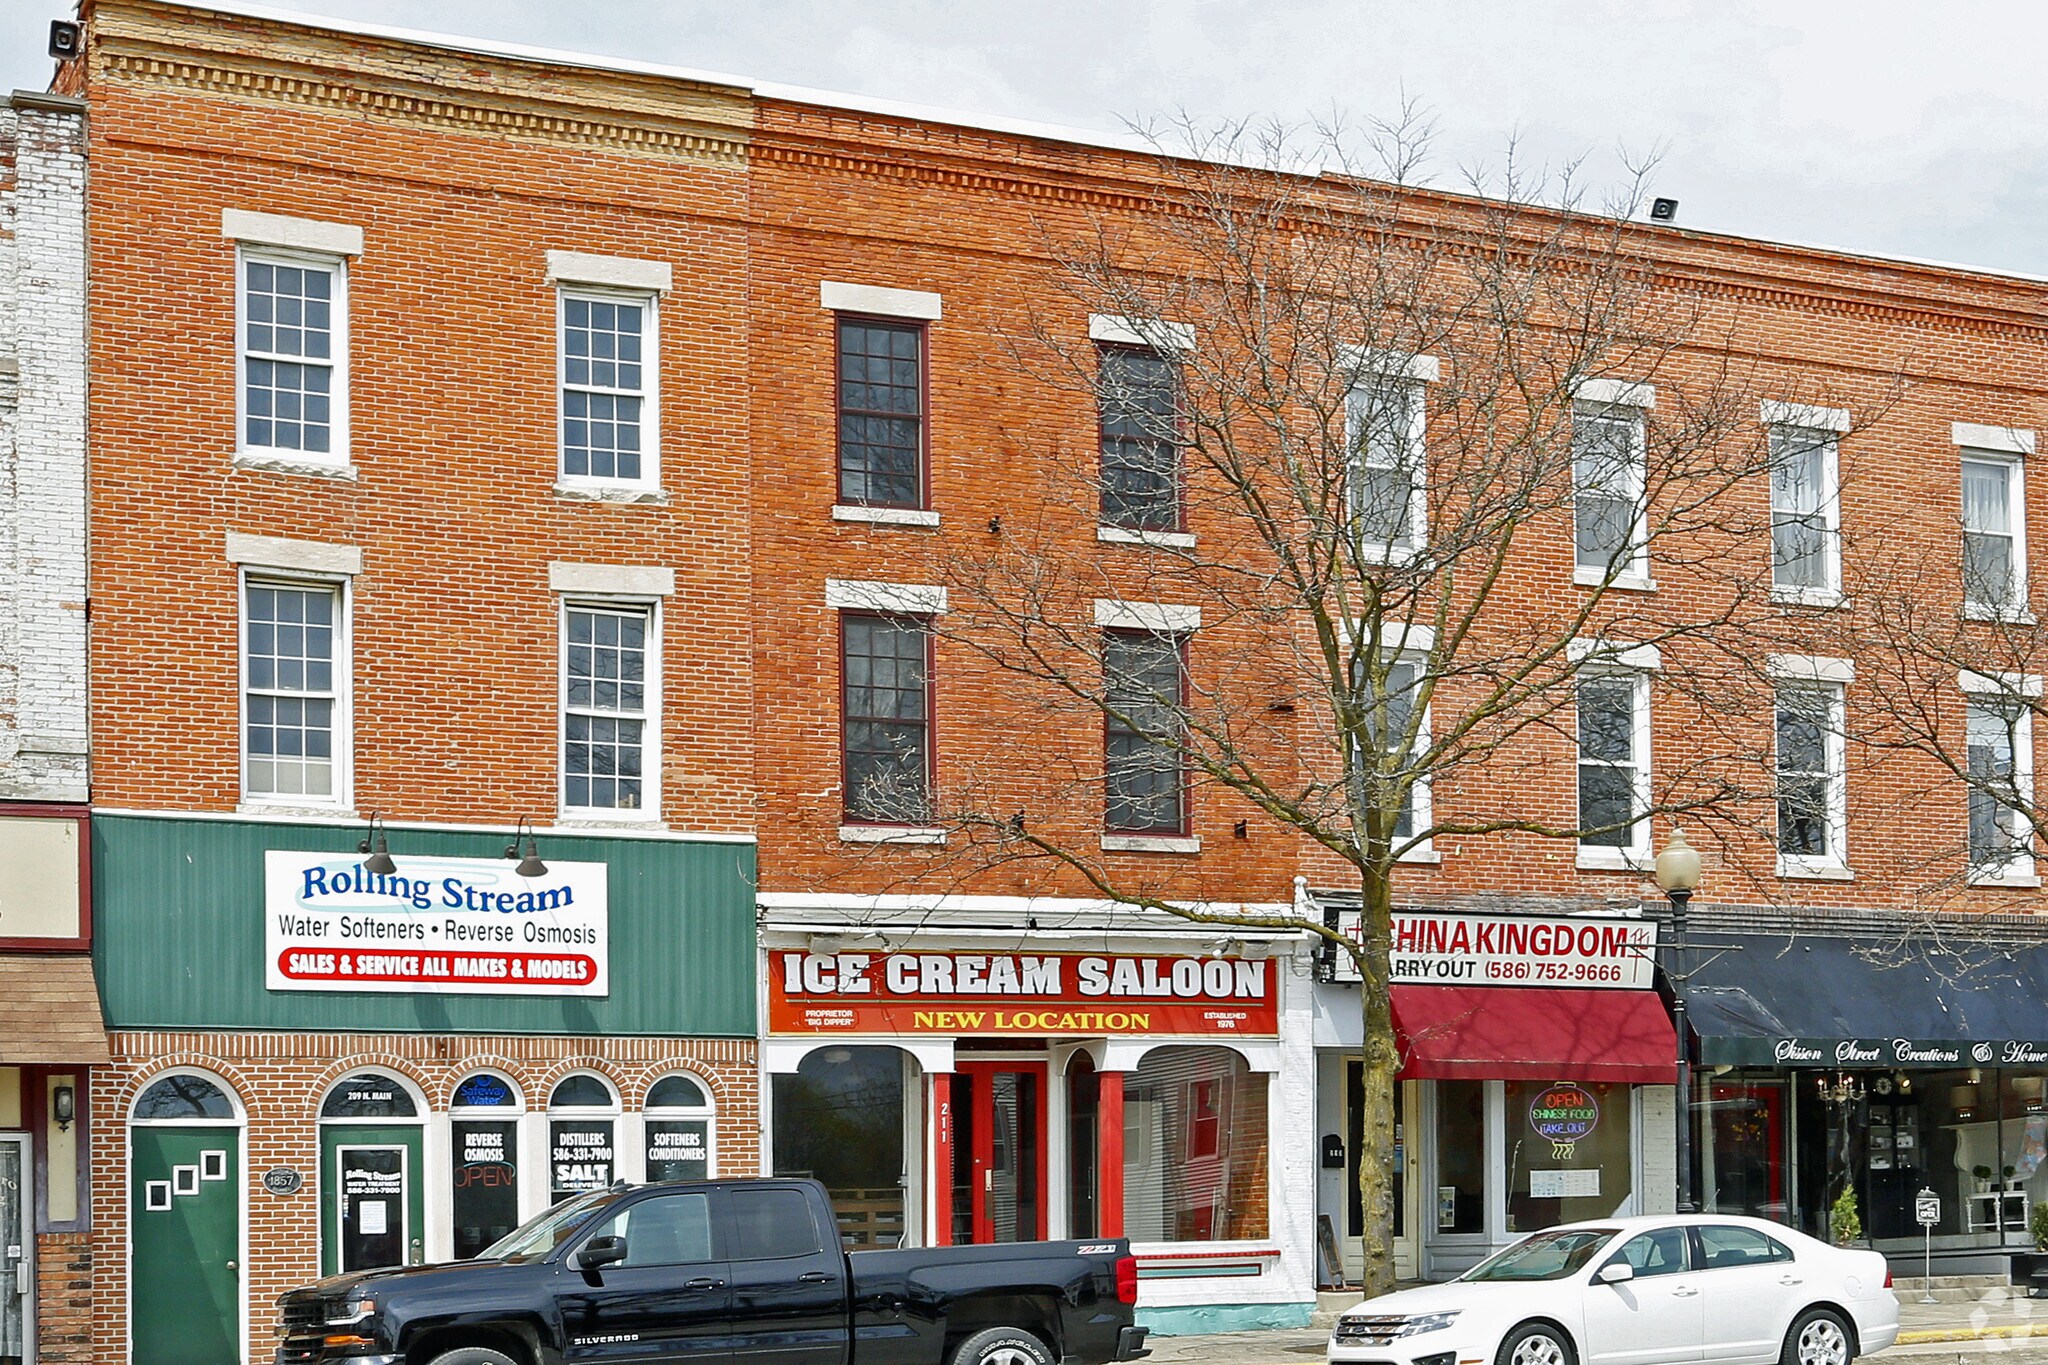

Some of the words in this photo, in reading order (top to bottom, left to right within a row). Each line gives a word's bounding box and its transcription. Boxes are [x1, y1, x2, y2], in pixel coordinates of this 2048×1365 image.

[302, 863, 431, 909] Rolling
[442, 878, 574, 913] Stream
[278, 915, 330, 937] Water
[340, 916, 425, 939] Softeners
[445, 919, 514, 942] Reverse
[523, 921, 596, 943] Osmosis
[1475, 922, 1628, 958] KINGDOM
[289, 953, 335, 974] SALES
[339, 954, 353, 974] &
[356, 955, 419, 976] SERVICE
[422, 956, 450, 976] ALL
[453, 957, 507, 978] MAKES
[511, 958, 524, 978] &
[527, 959, 588, 980] MODELS
[1388, 959, 1431, 977] RRY
[1436, 960, 1476, 978] OUT
[1485, 961, 1530, 979] (586)
[1535, 963, 1621, 981] 752-9666
[784, 954, 871, 994] ICE
[886, 956, 1062, 995] CREAM
[1077, 959, 1266, 998] SALOON
[913, 1012, 986, 1028] NEW
[993, 1012, 1150, 1030] LOCATION
[1204, 1012, 1247, 1020] ESTABLISHED
[1217, 1020, 1236, 1028] 1976
[1775, 1038, 1823, 1064] Sisson
[1835, 1039, 1881, 1065] Street
[1892, 1038, 1960, 1063] Creations
[1971, 1042, 1994, 1063] &
[2001, 1040, 2048, 1063] Home
[347, 1091, 361, 1100] 209
[371, 1091, 392, 1100] MAIN
[461, 1085, 507, 1099] Safeway
[467, 1096, 500, 1105] Water
[1545, 1092, 1584, 1108] OPEN
[1570, 1108, 1595, 1119] FOOD
[941, 1102, 949, 1143] 211
[1541, 1122, 1564, 1134] TAKE
[1567, 1122, 1586, 1133] OUT
[465, 1133, 503, 1147] REVERSE
[559, 1133, 605, 1146] DISTILLERS
[654, 1133, 700, 1146] SOFTENERS
[463, 1148, 504, 1162] OSMOSIS
[553, 1148, 612, 1161] 586-331-7900
[649, 1148, 706, 1161] CONDITIONERS
[345, 1169, 373, 1181] Rolling
[454, 1166, 512, 1187] OPEN
[557, 1164, 608, 1181] SALT
[270, 1175, 293, 1186] 1857
[574, 1334, 639, 1345] SILVERADO
